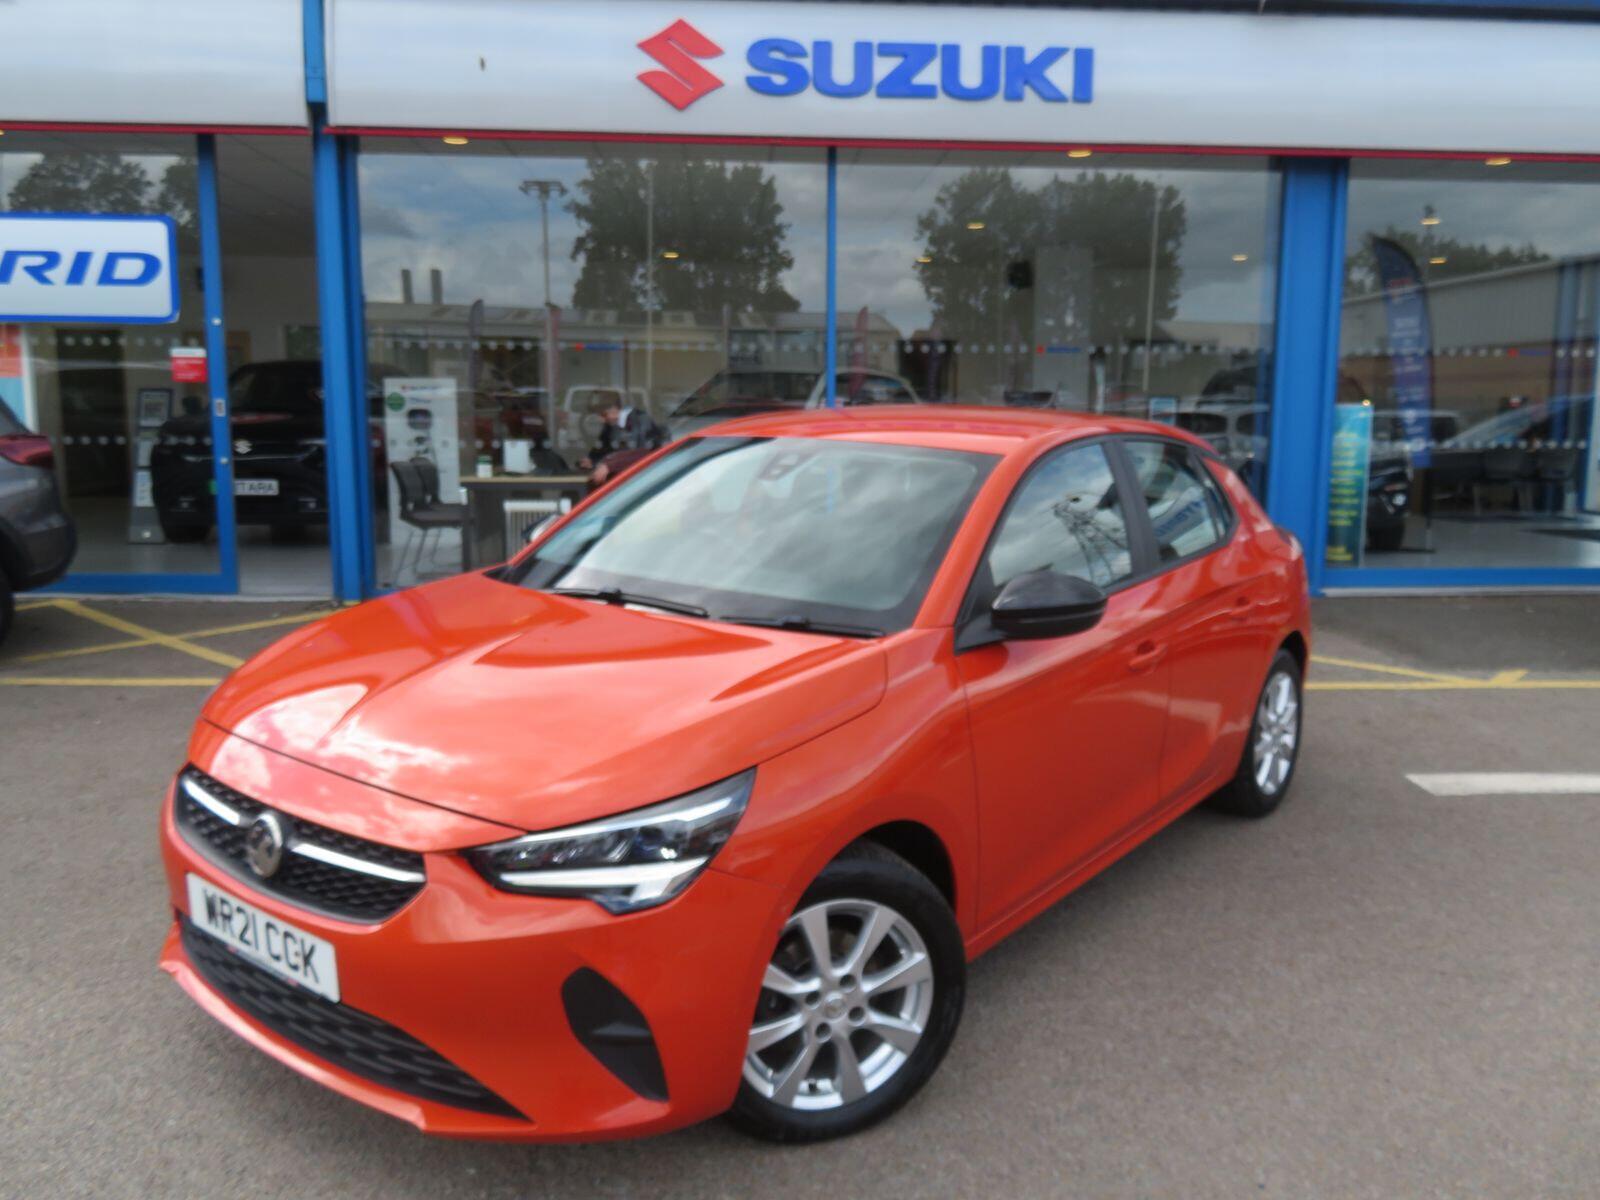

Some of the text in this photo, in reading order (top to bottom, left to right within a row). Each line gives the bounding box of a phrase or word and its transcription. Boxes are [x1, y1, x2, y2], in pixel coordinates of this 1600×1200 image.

[746, 38, 1094, 103] SUZUKI
[0, 250, 161, 286] RID
[202, 888, 258, 950] WR21
